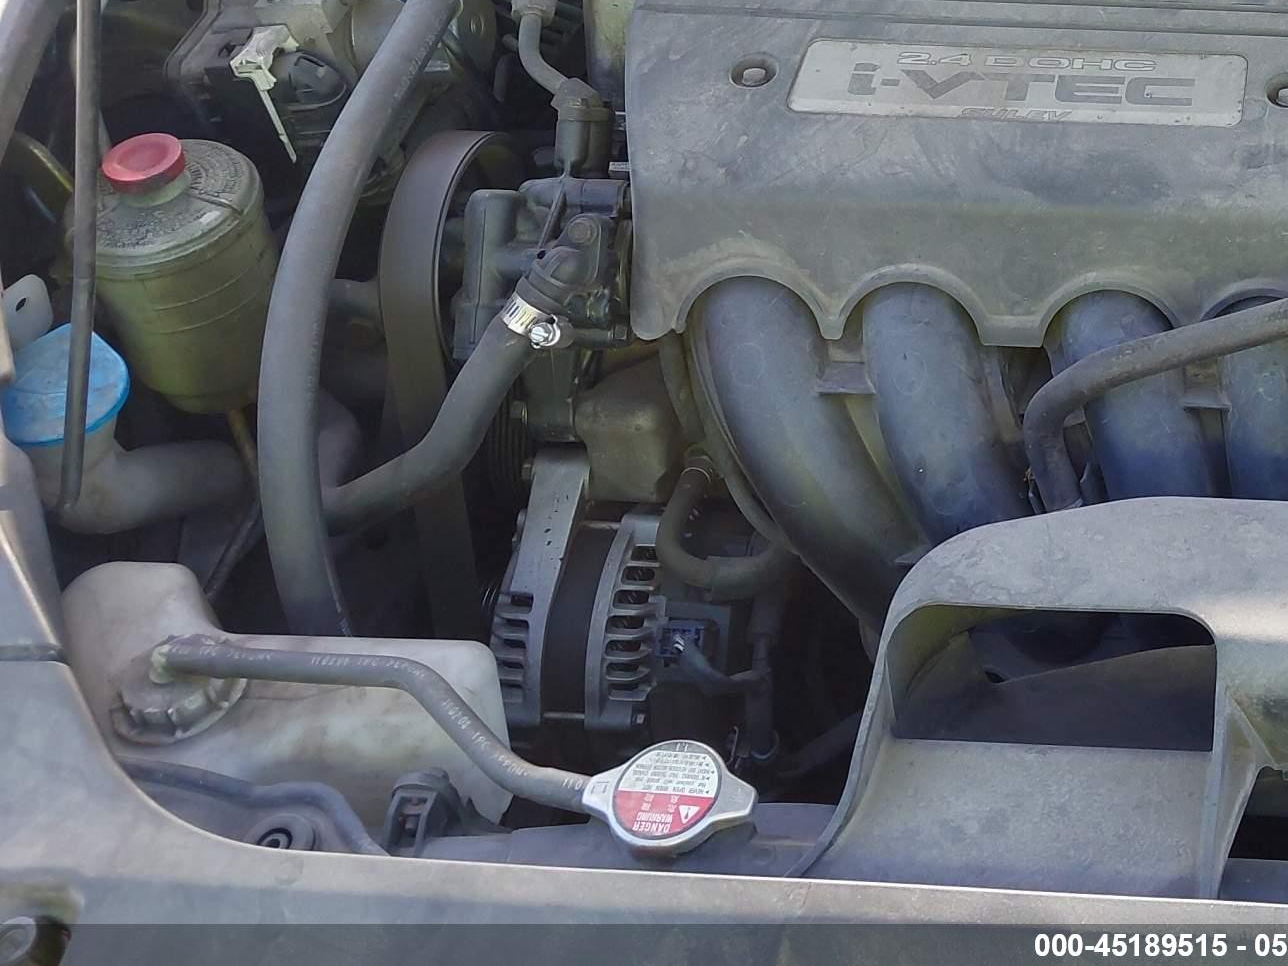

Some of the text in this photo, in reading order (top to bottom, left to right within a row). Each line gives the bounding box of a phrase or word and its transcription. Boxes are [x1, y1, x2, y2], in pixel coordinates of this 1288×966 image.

[898, 51, 1157, 72] 2.4 DOHC
[847, 61, 1195, 106] i-VTEC
[635, 810, 672, 824] WARNING
[631, 819, 670, 834] DANGER
